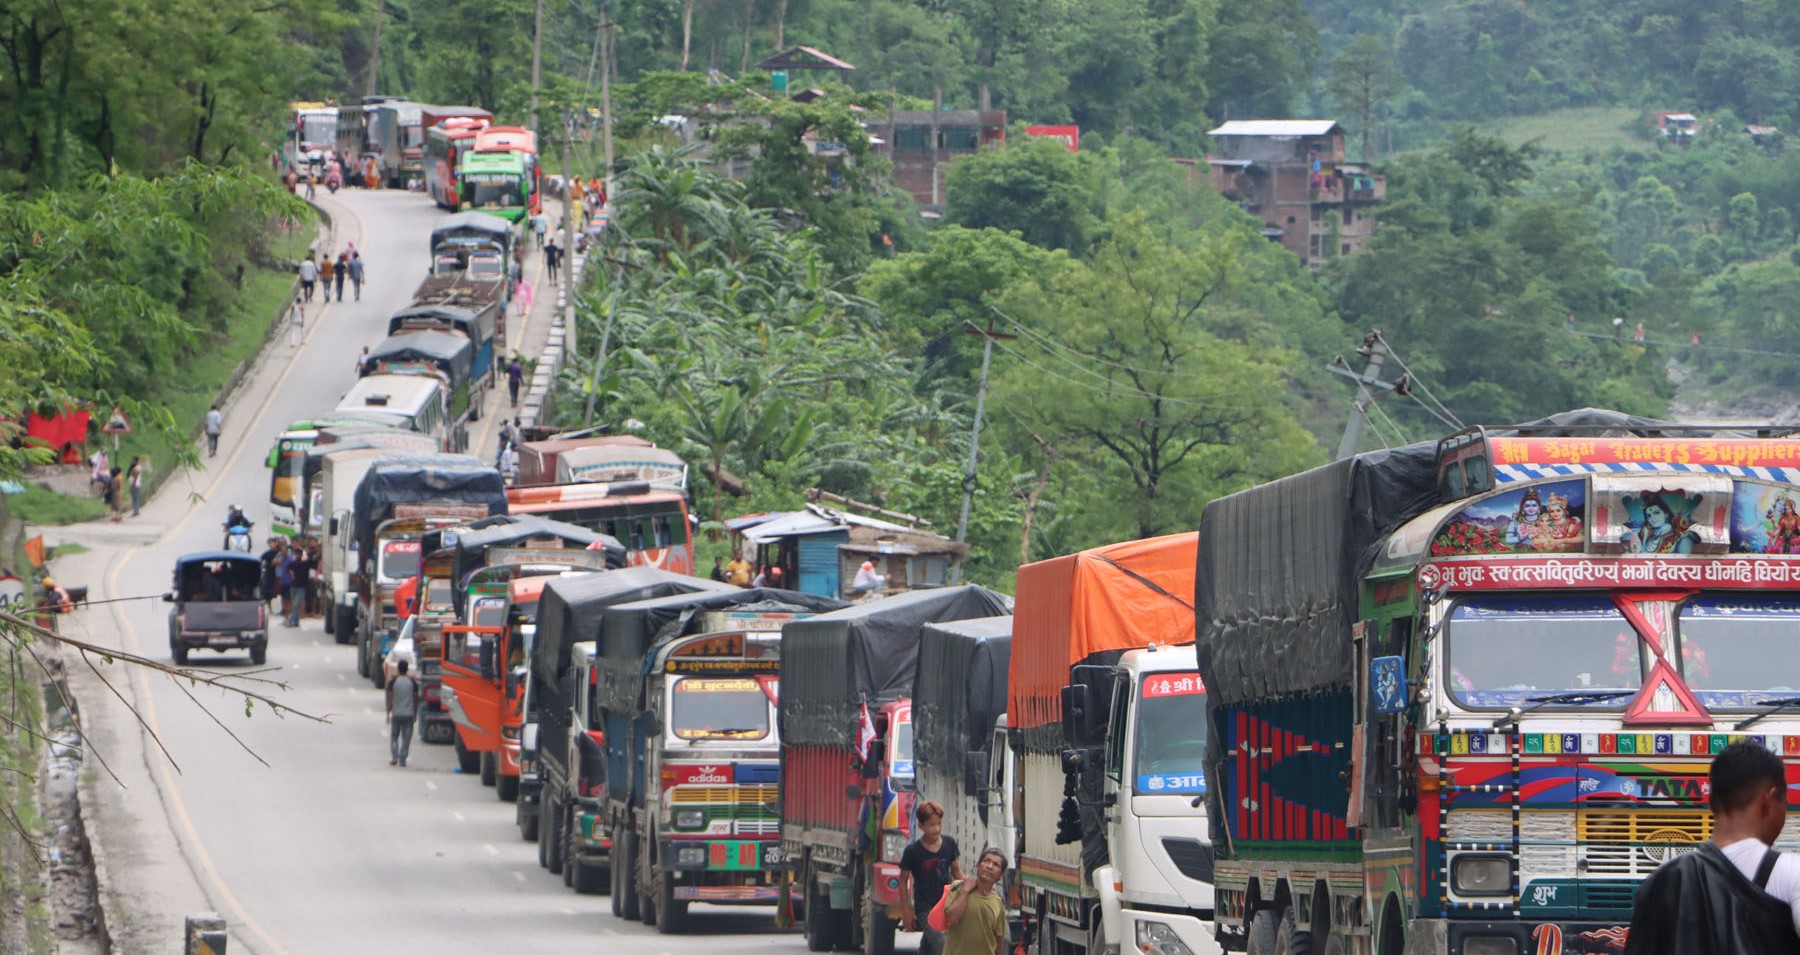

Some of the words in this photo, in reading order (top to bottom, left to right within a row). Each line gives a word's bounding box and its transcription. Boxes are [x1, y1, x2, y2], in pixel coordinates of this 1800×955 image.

[1499, 442, 1529, 462] New
[1610, 443, 1690, 464] Traders
[1622, 560, 1654, 581] भर्गो
[1656, 560, 1702, 582] देवस्य
[688, 774, 727, 783] adidas
[1637, 779, 1703, 797] TATA
[1532, 886, 1558, 905] शुभ
